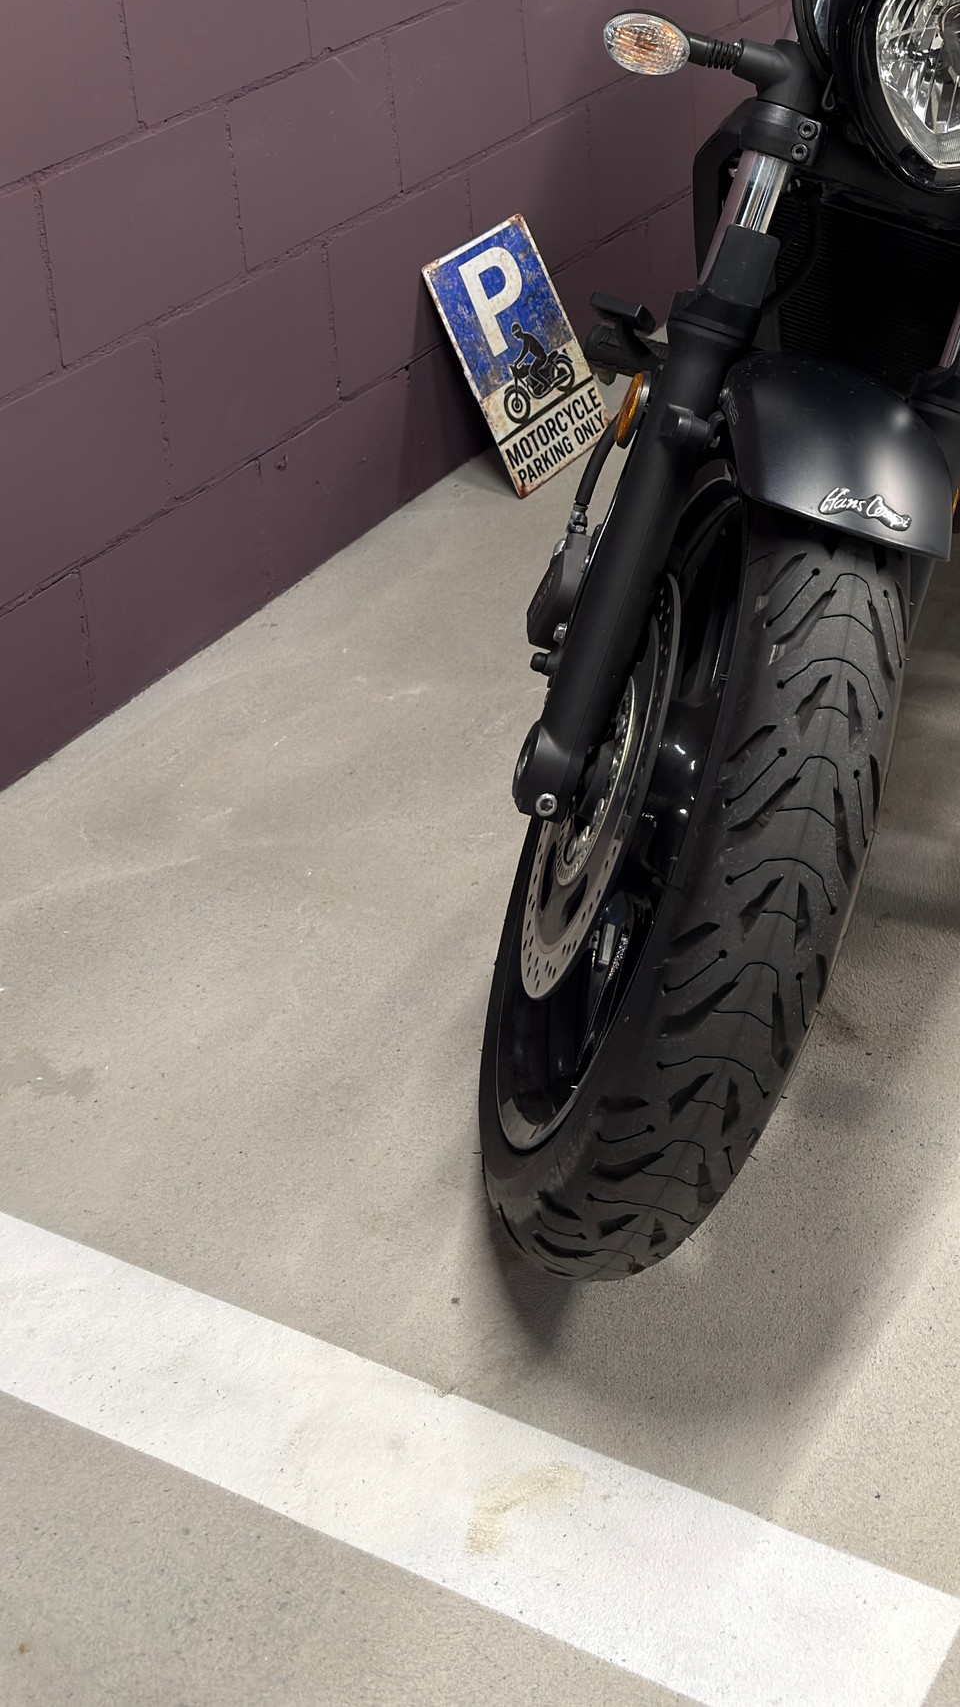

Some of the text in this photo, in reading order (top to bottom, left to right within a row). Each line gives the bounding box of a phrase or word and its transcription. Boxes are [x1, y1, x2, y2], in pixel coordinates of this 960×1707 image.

[458, 246, 522, 356] P
[505, 387, 602, 470] MOTORCYCLE
[517, 411, 605, 487] PARKING ONLY
[819, 487, 867, 513] Hans
